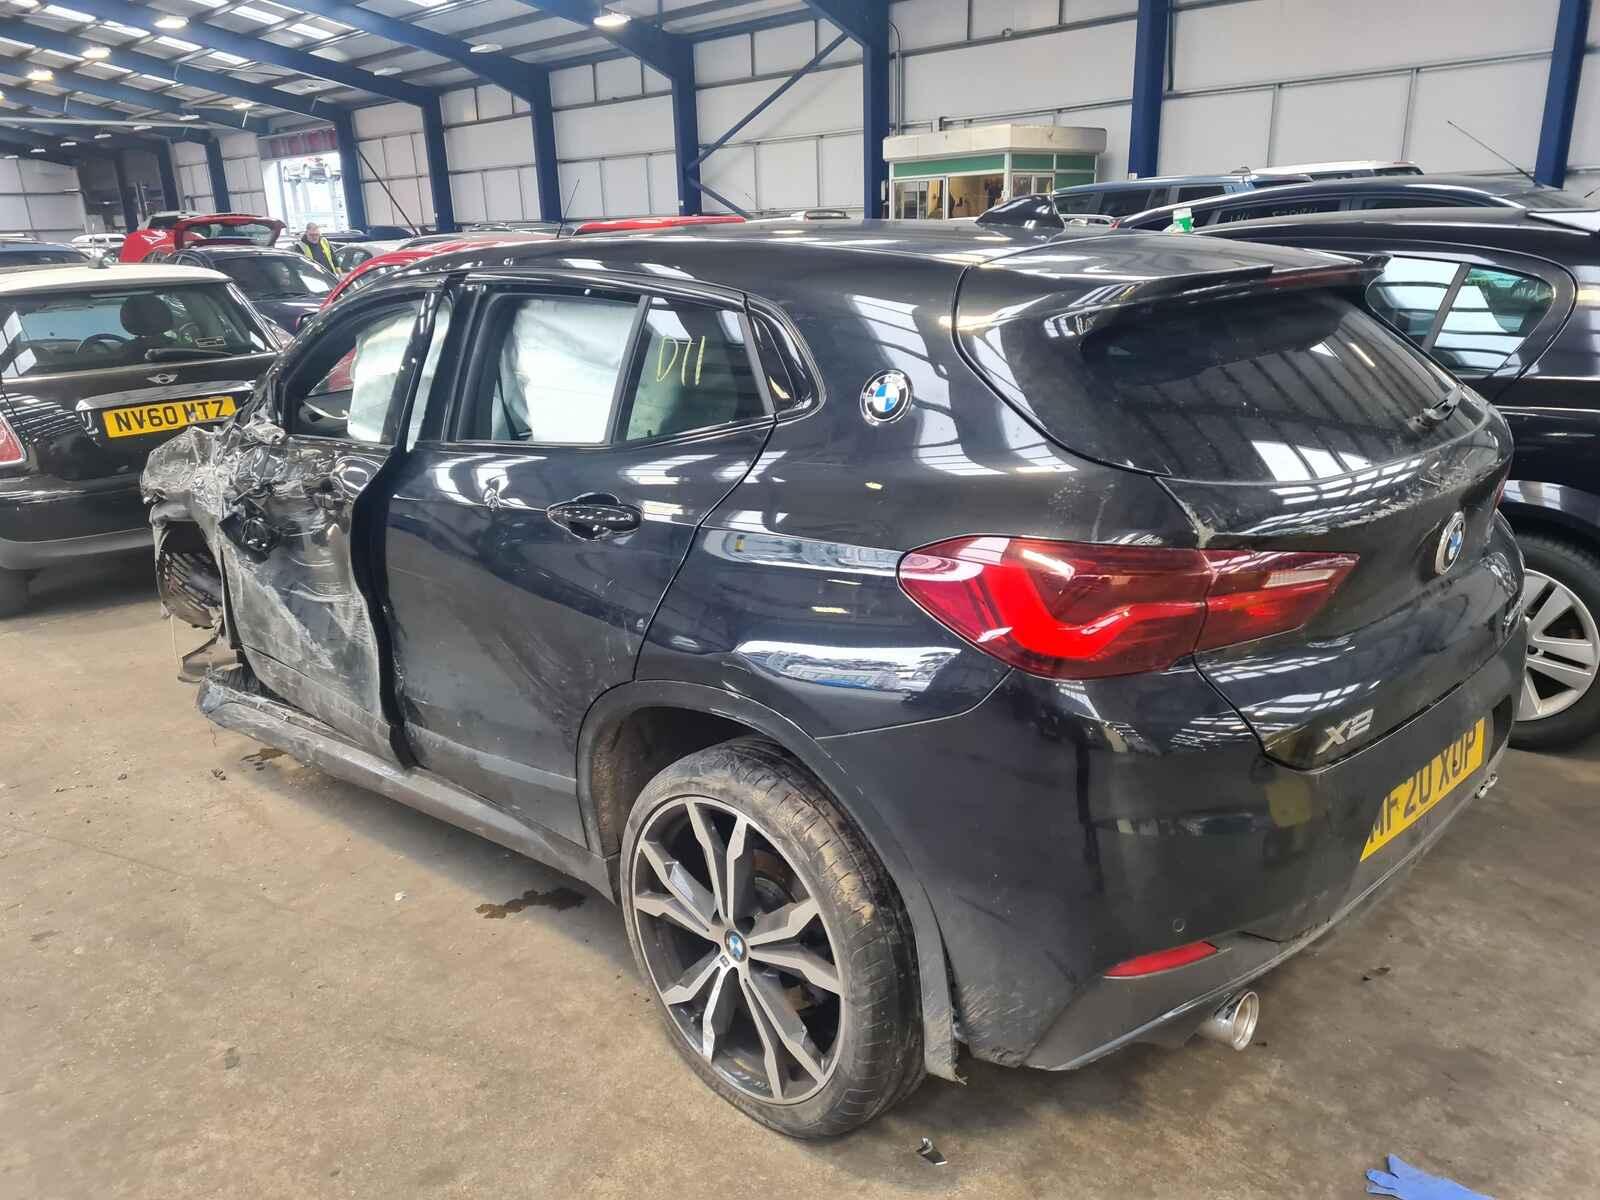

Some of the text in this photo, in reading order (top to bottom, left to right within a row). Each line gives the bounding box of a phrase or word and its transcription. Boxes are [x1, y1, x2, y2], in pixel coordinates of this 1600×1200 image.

[114, 400, 224, 432] NV60 MTZ
[1315, 709, 1374, 754] X2
